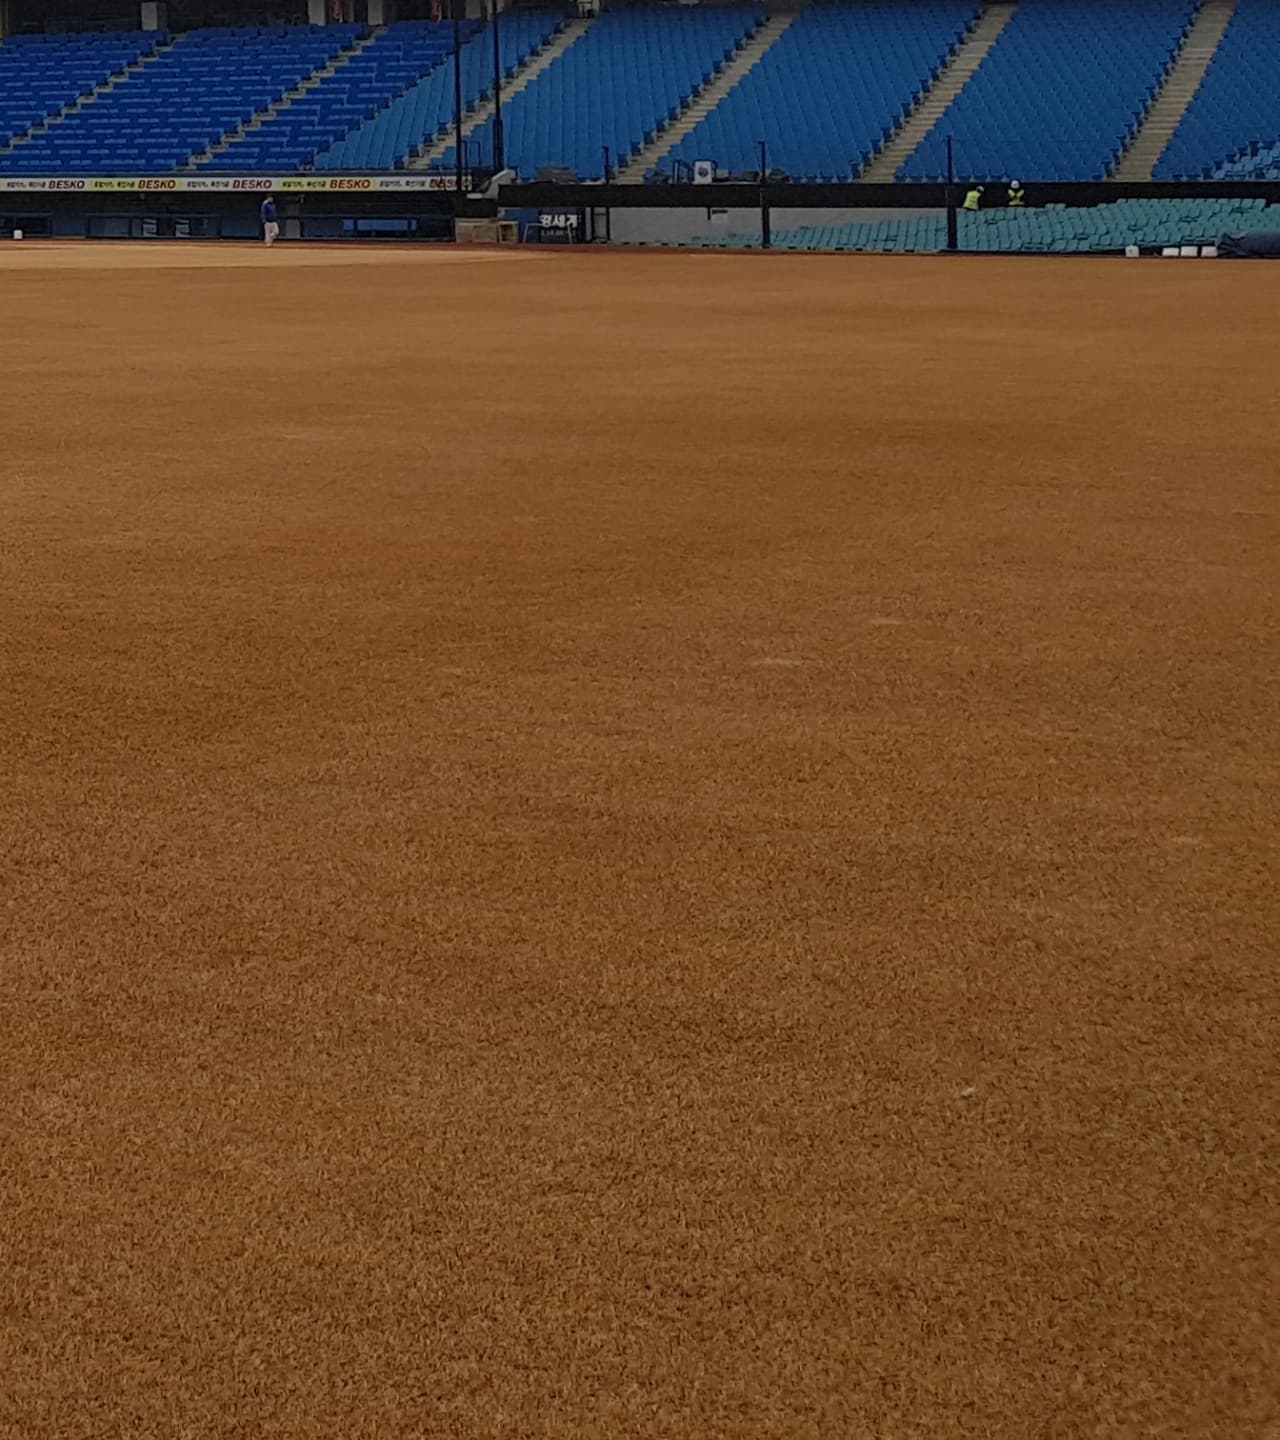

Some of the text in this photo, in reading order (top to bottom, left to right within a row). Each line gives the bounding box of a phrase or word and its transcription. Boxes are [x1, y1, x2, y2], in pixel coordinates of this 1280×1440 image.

[47, 180, 85, 190] BESKO
[137, 179, 177, 190] BESKO
[232, 179, 273, 189] BESKO
[329, 179, 371, 189] BESKO
